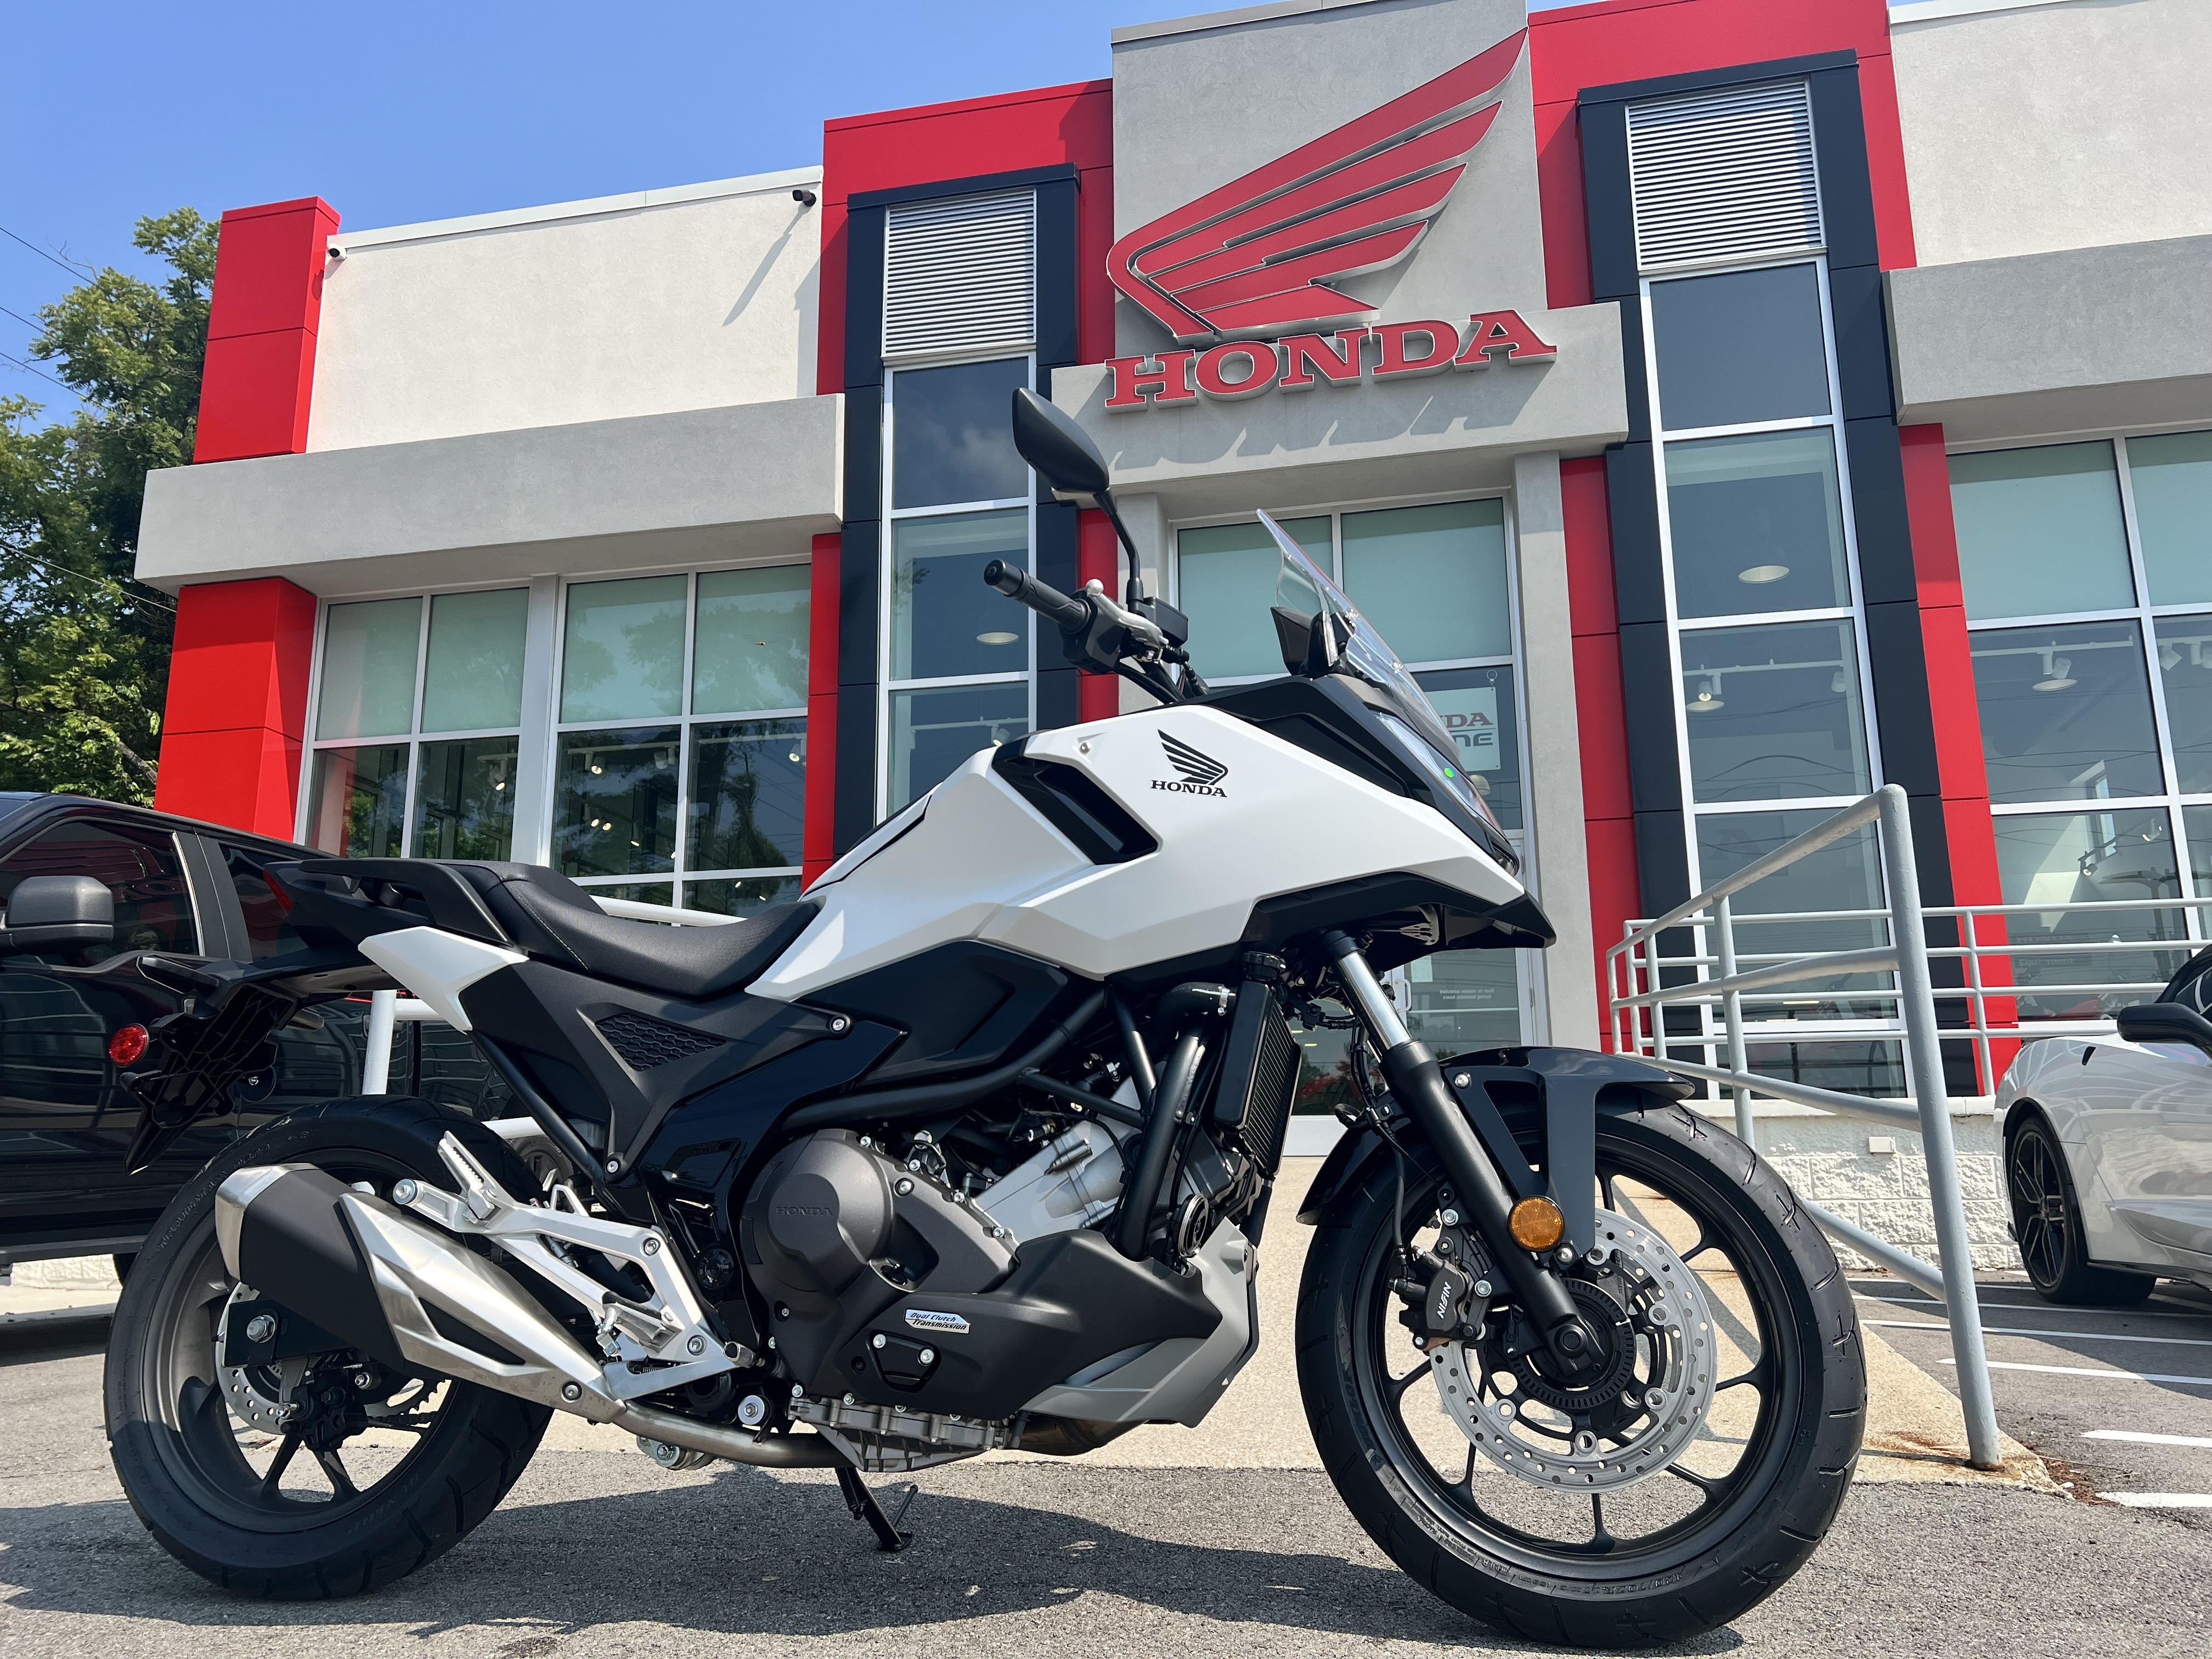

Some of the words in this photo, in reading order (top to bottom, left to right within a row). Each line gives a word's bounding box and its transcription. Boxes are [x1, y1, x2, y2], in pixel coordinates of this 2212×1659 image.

[1104, 309, 1557, 411] HONDA
[1150, 780, 1227, 797] HONDA
[775, 1206, 833, 1216] HONDA
[1437, 1281, 1452, 1319] NISSIN
[911, 1319, 967, 1330] Transmission
[930, 1314, 956, 1323] Clutch
